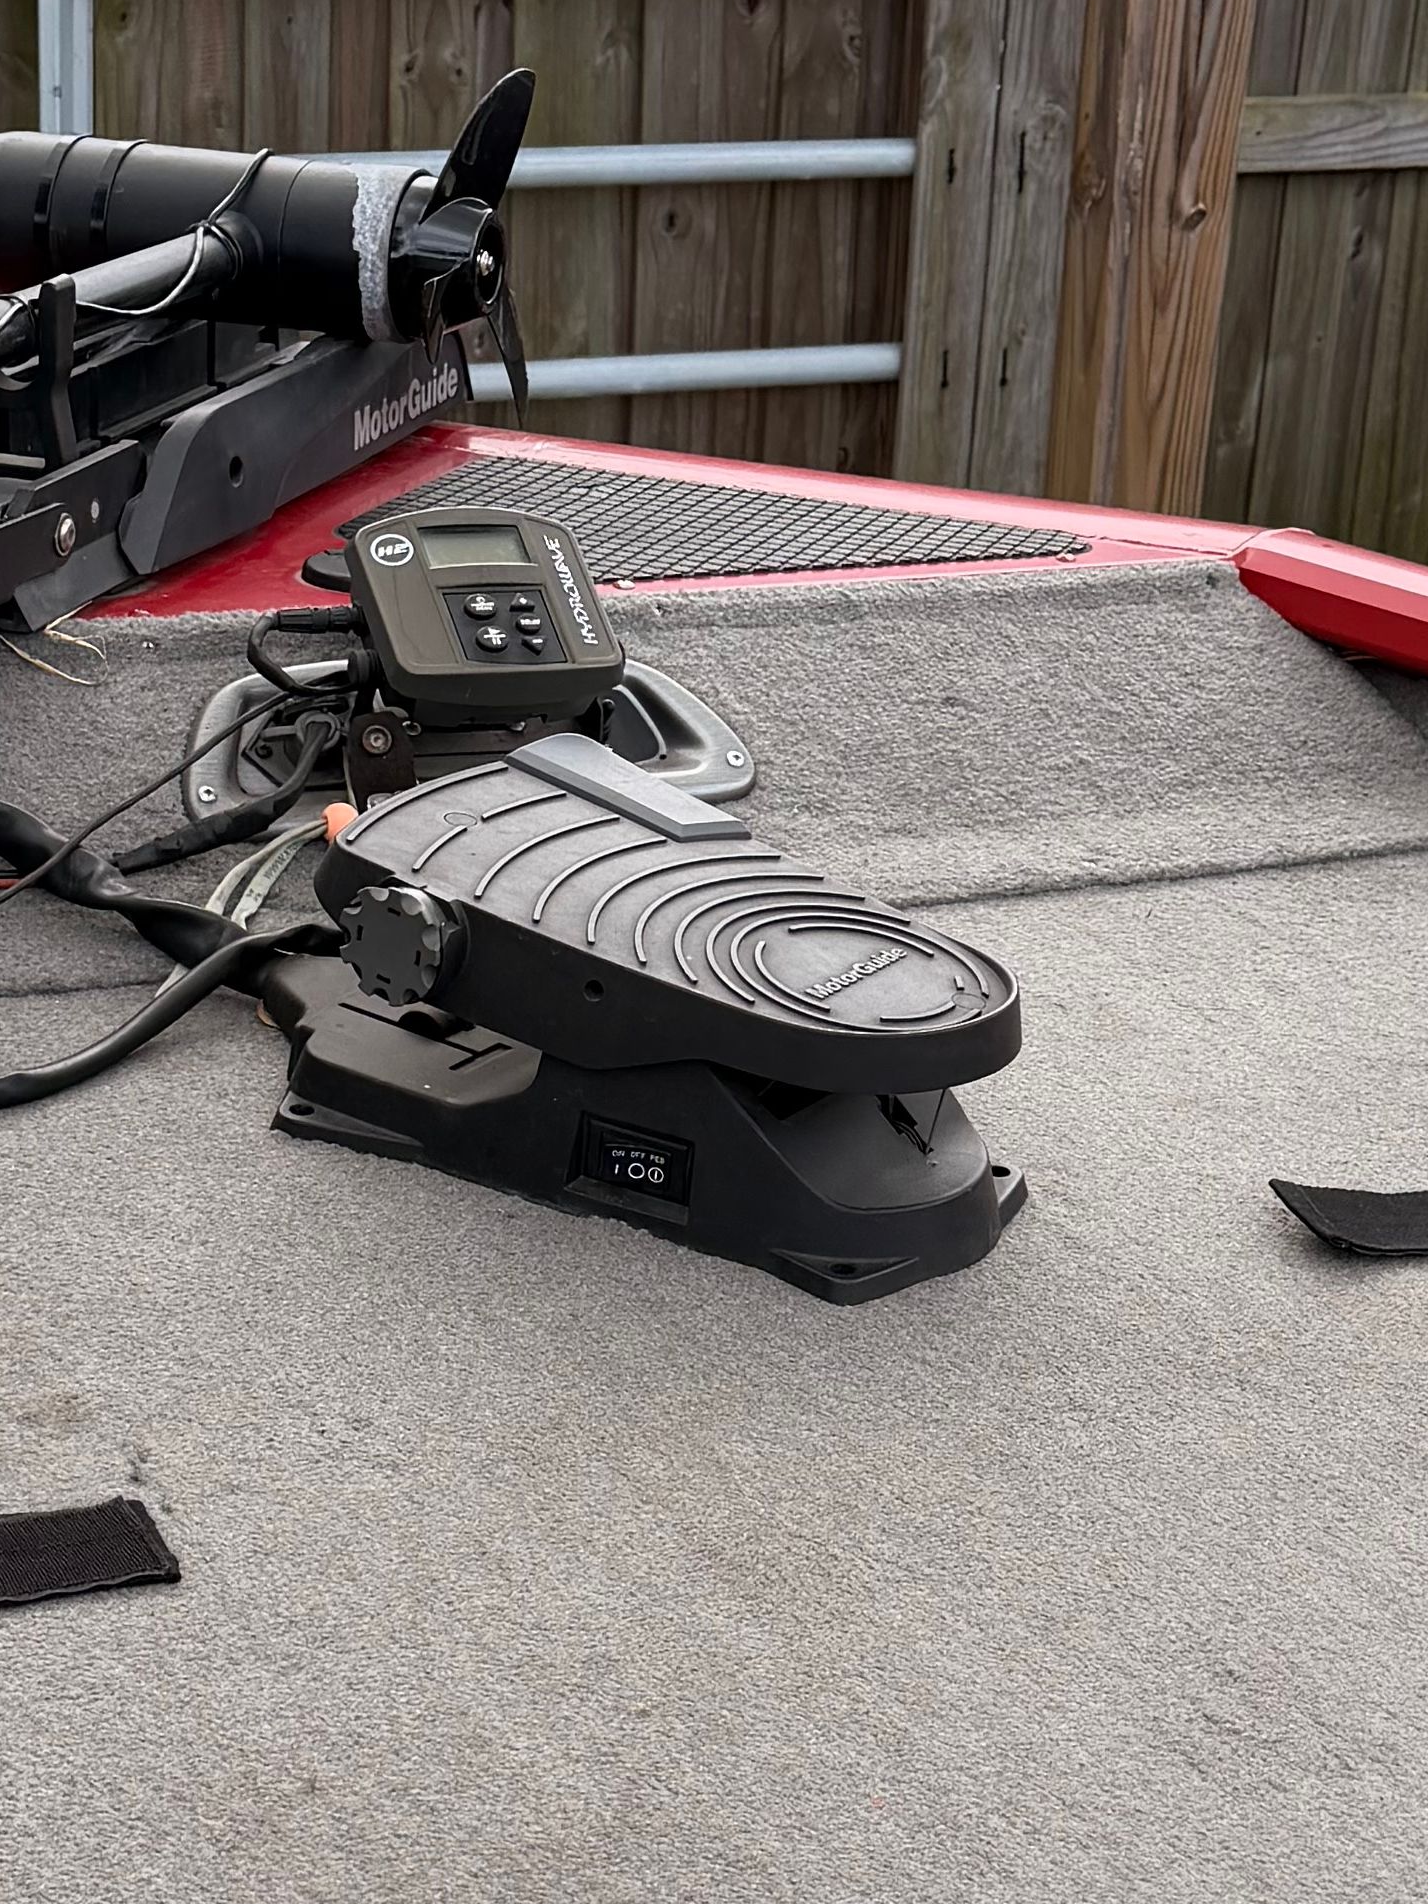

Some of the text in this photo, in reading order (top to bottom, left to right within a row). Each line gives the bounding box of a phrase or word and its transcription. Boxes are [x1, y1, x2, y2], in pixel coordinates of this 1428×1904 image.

[353, 362, 459, 451] MotorGuide
[543, 534, 599, 646] HYDROWAVE
[803, 946, 909, 1000] MotorGuide
